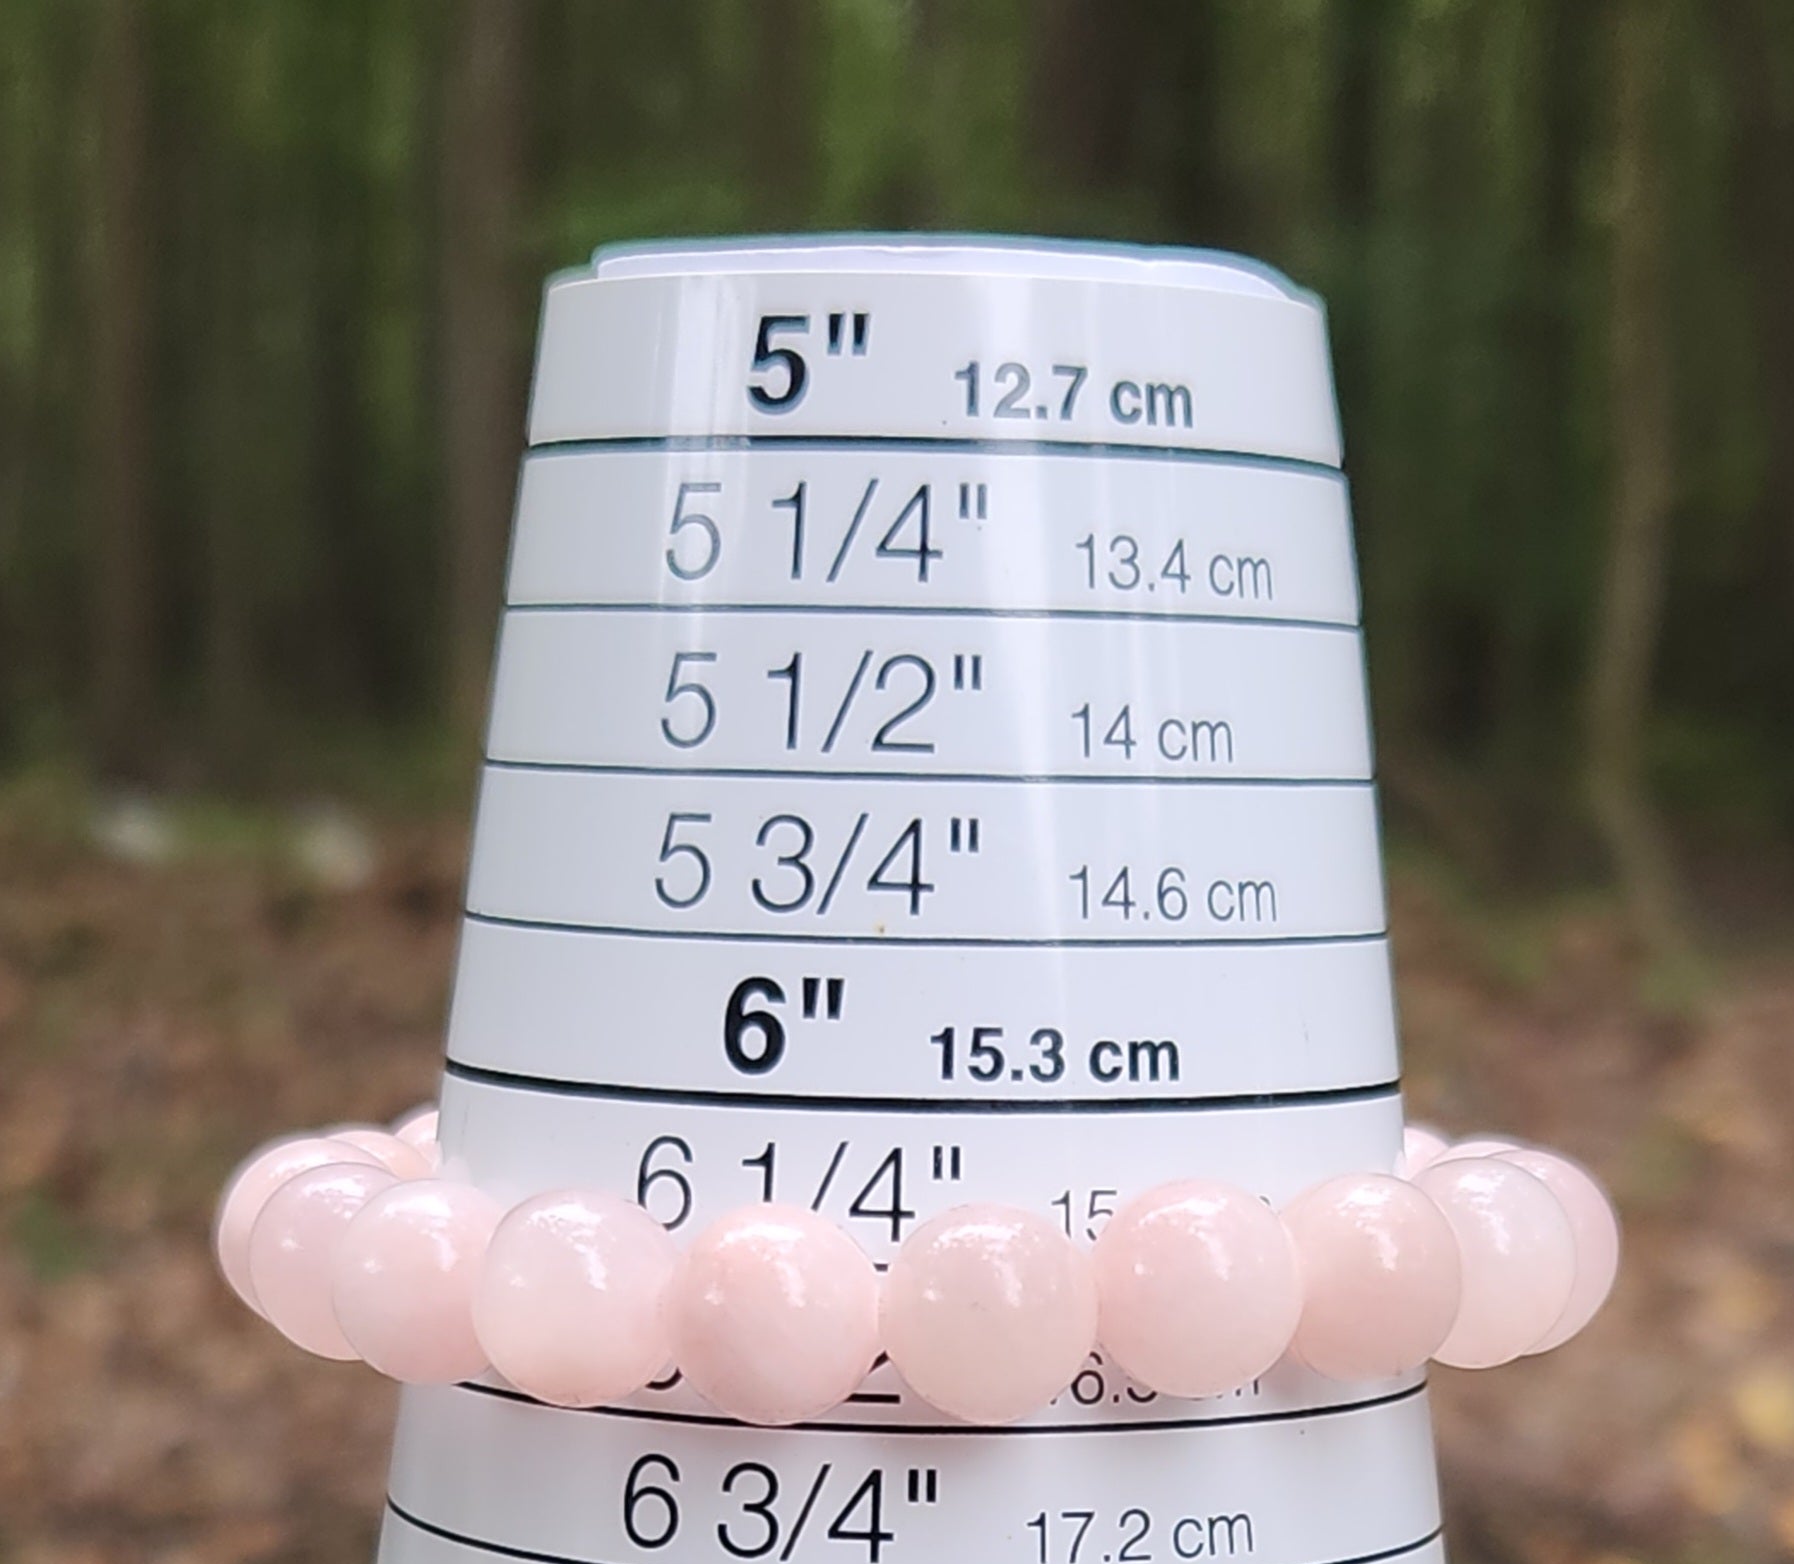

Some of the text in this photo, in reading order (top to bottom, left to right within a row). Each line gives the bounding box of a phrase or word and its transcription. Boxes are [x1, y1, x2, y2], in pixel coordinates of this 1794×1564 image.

[747, 312, 1193, 429] 5" 12.7 cm
[665, 477, 1273, 601] 5 1/4" 13.4 cm
[660, 649, 1234, 763] 5 1/2" 14 cm
[654, 811, 1277, 922] 5 3/4" 14.6 cm
[723, 976, 1180, 1083] 6" 15.3 cm
[637, 1134, 1118, 1243] 6 1/4" 15
[623, 1453, 1254, 1564] 6 3/4" 17.2 cm
